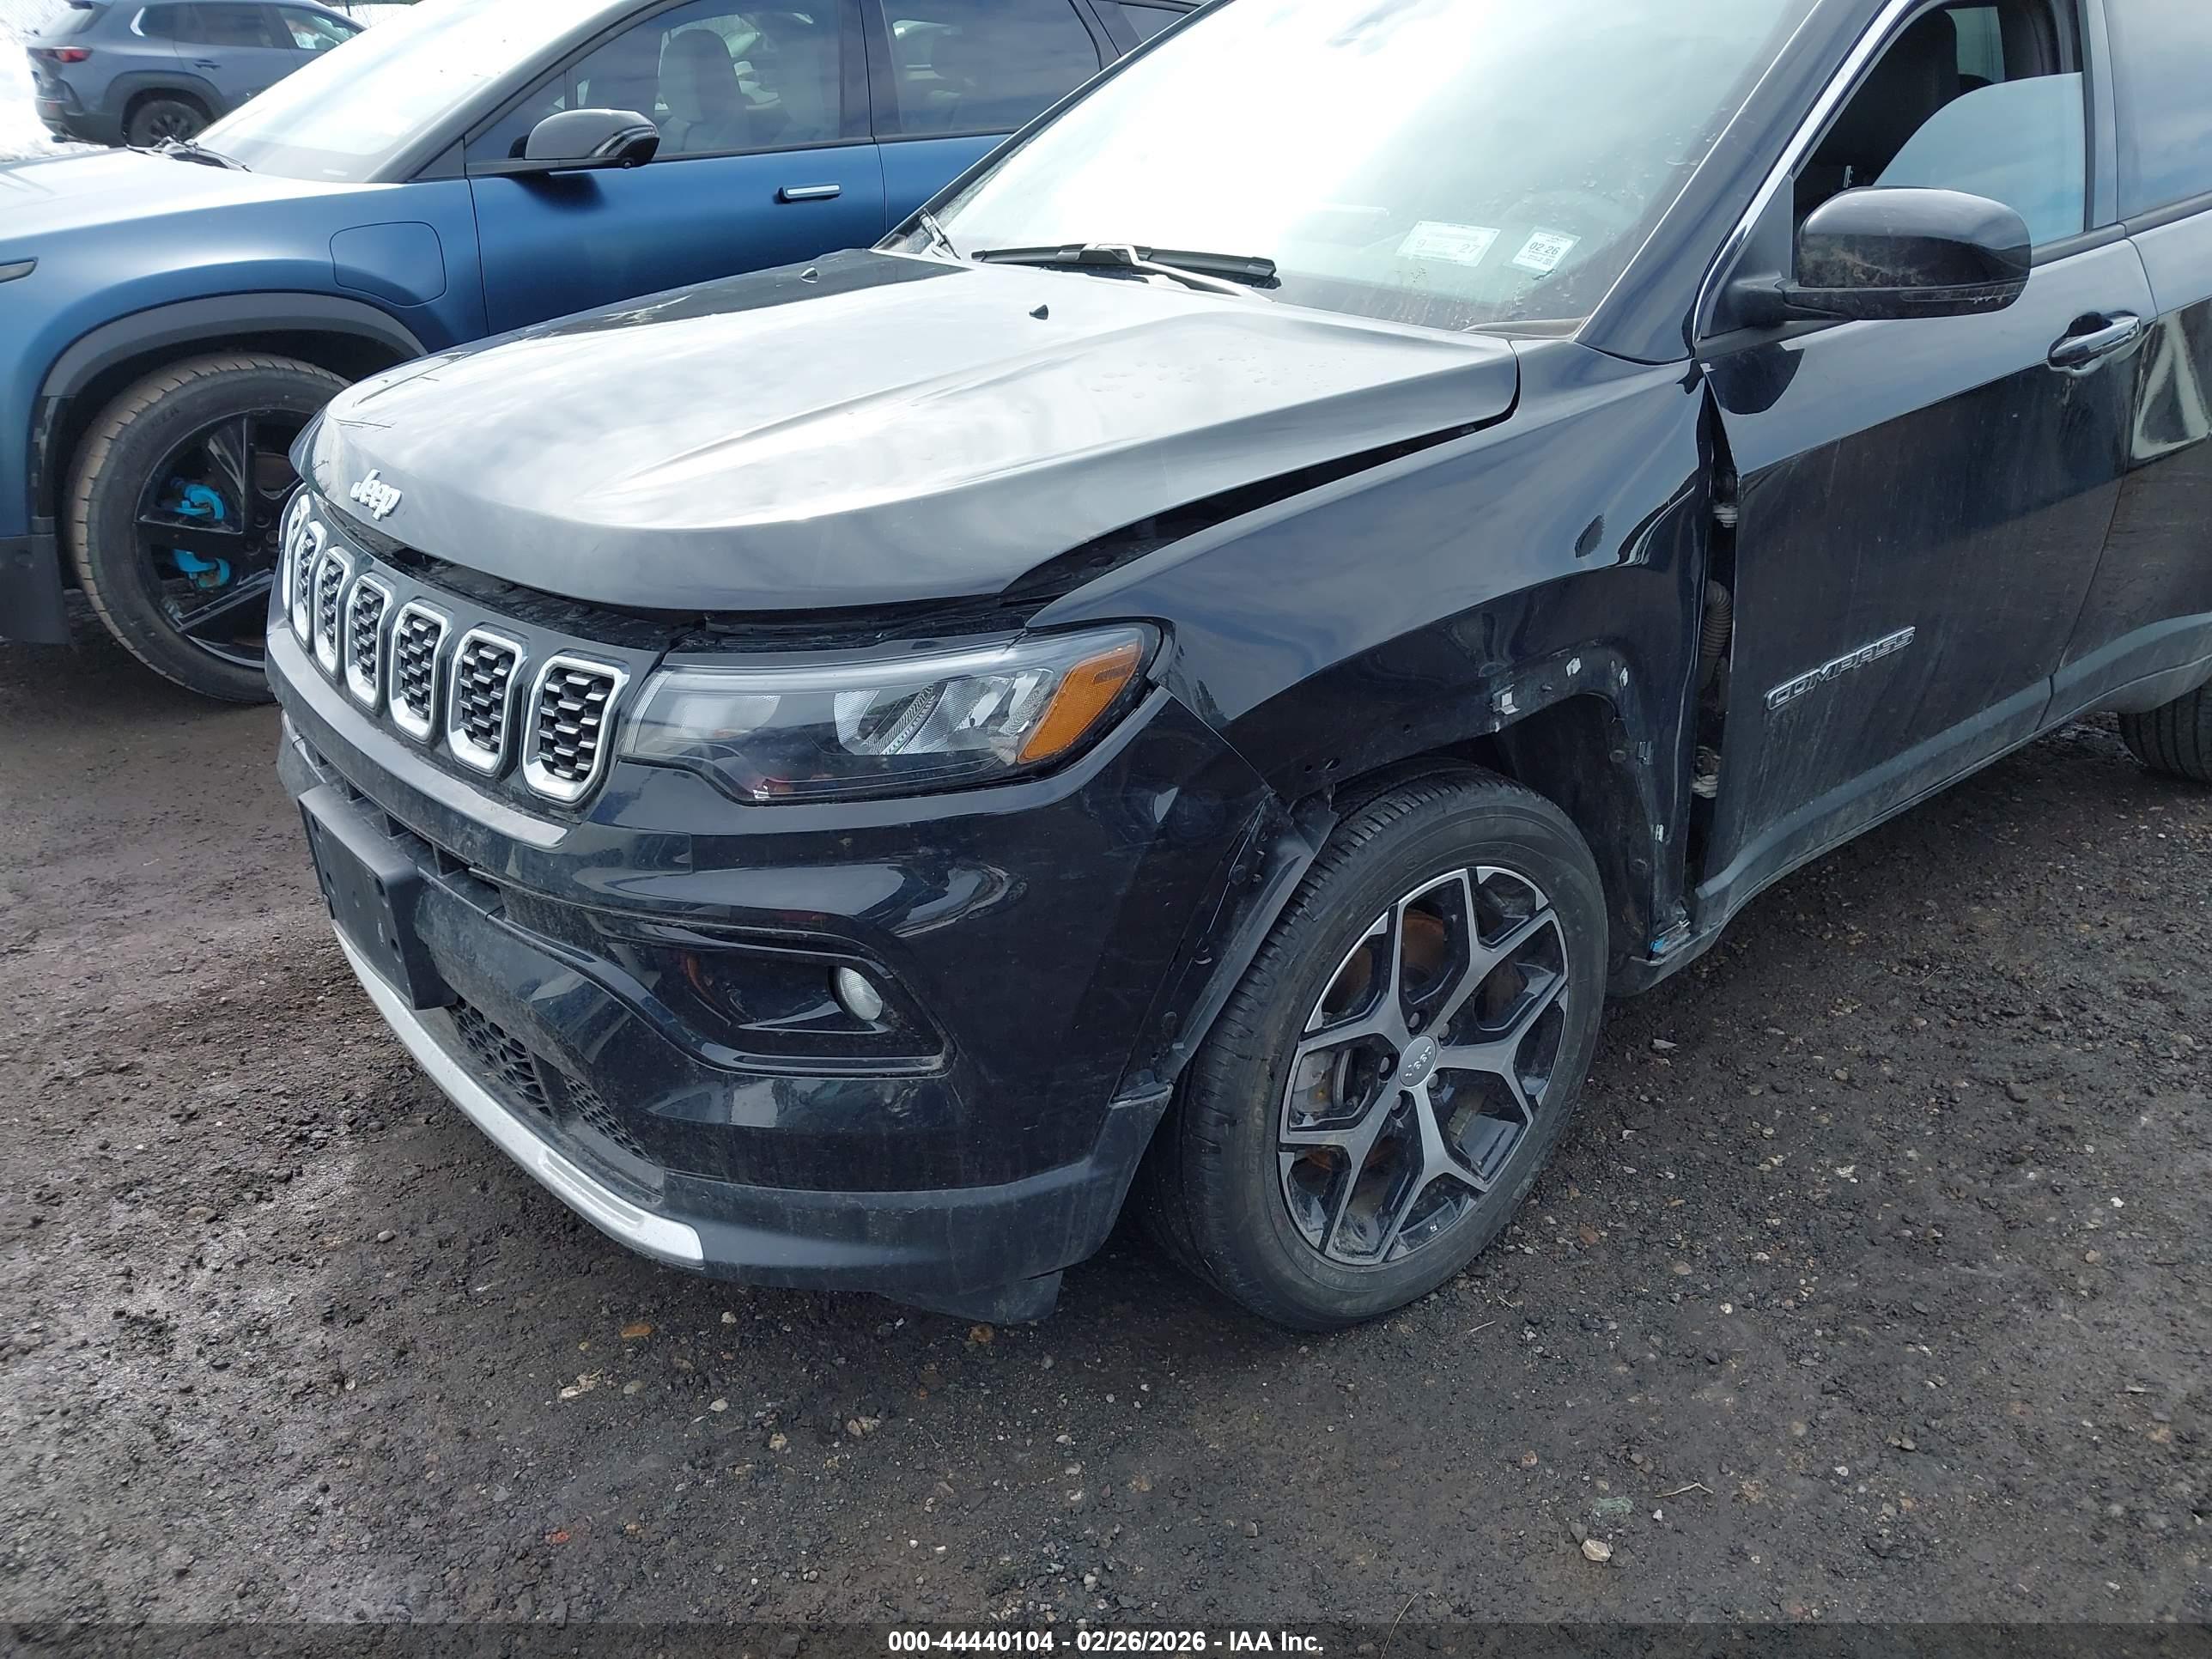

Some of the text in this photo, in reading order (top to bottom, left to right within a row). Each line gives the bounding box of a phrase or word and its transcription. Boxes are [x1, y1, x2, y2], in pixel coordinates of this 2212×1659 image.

[1458, 243, 1481, 254] 27
[350, 469, 402, 521] Jeep
[1764, 626, 1916, 710] COMPASS
